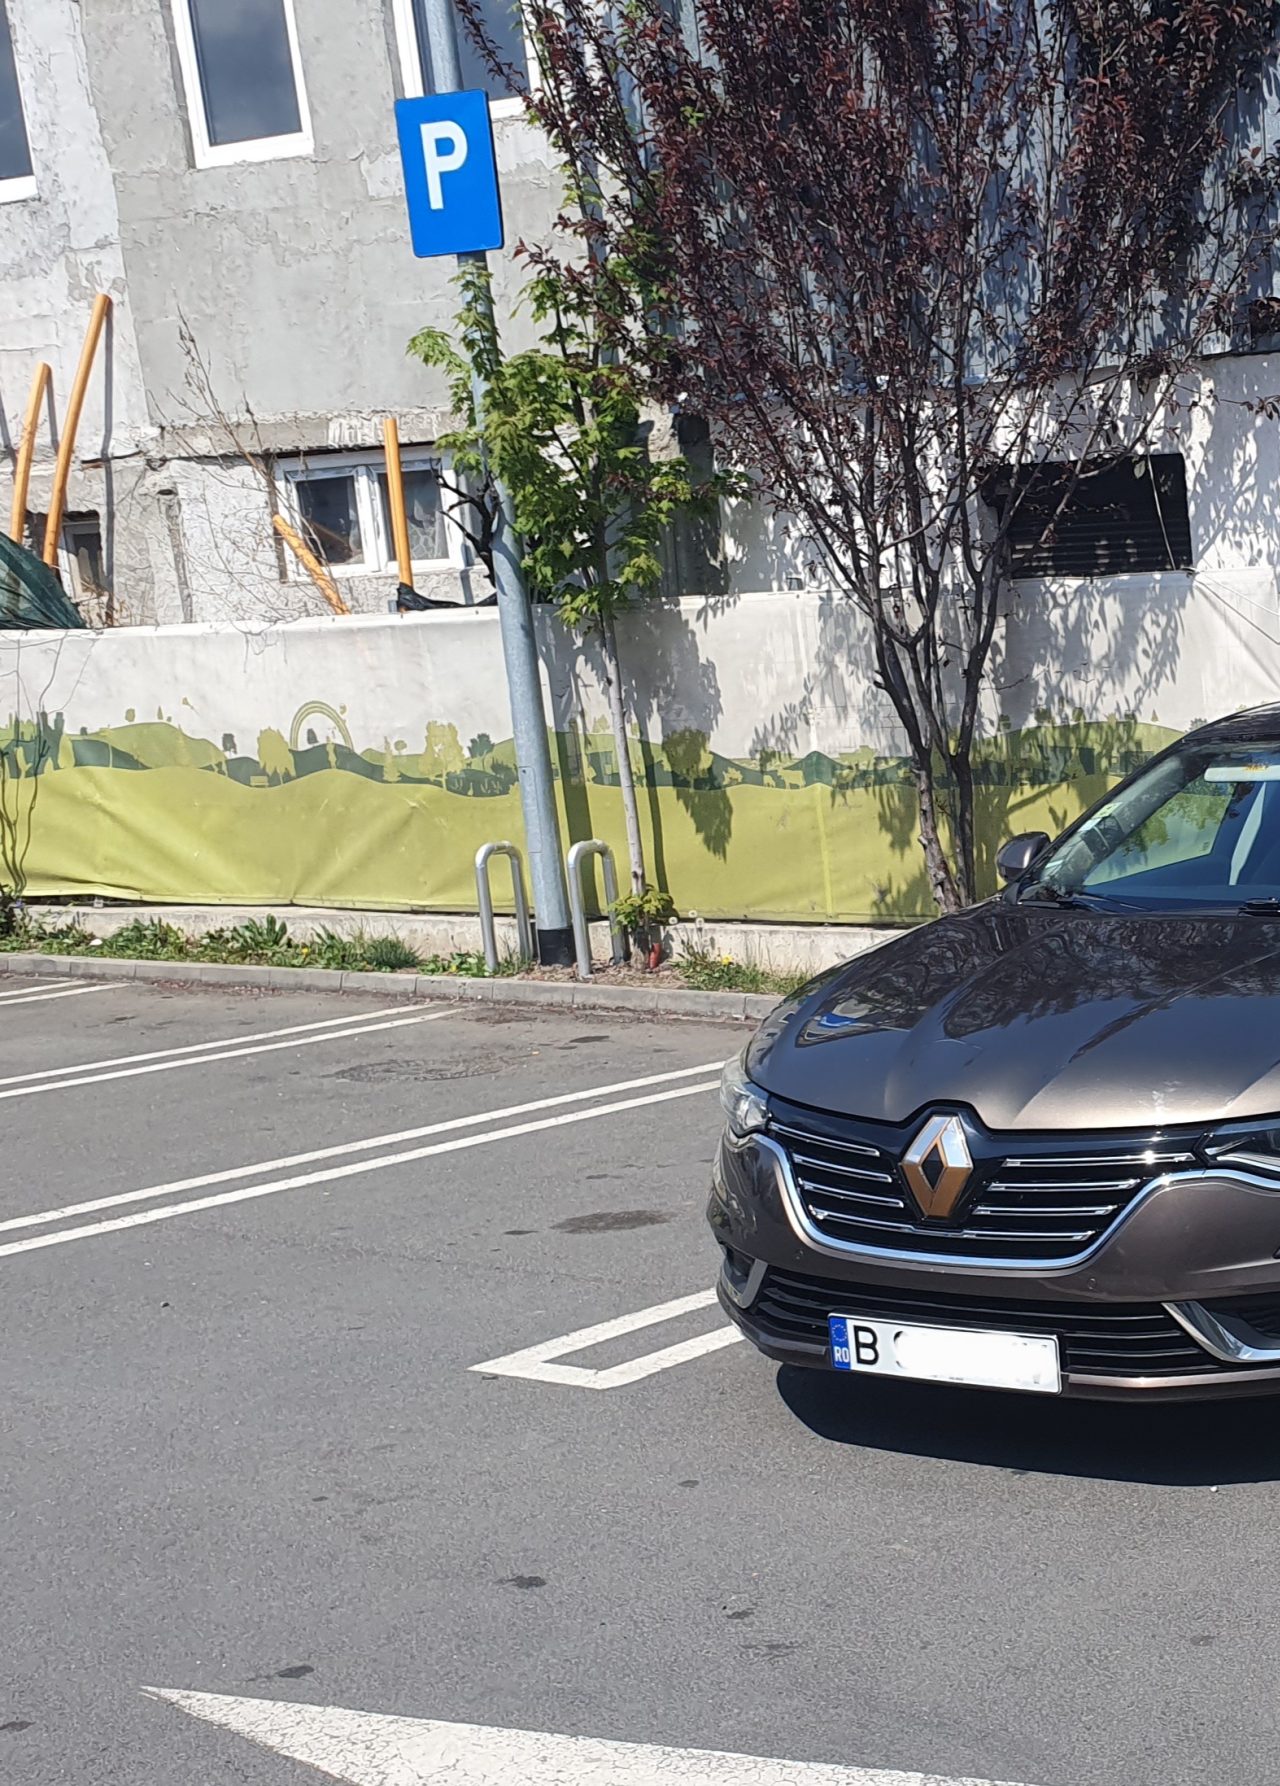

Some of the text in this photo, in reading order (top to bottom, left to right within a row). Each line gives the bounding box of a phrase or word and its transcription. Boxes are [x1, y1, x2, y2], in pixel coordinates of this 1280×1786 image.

[420, 120, 468, 210] P
[833, 1345, 850, 1363] RO
[853, 1325, 880, 1366] B
